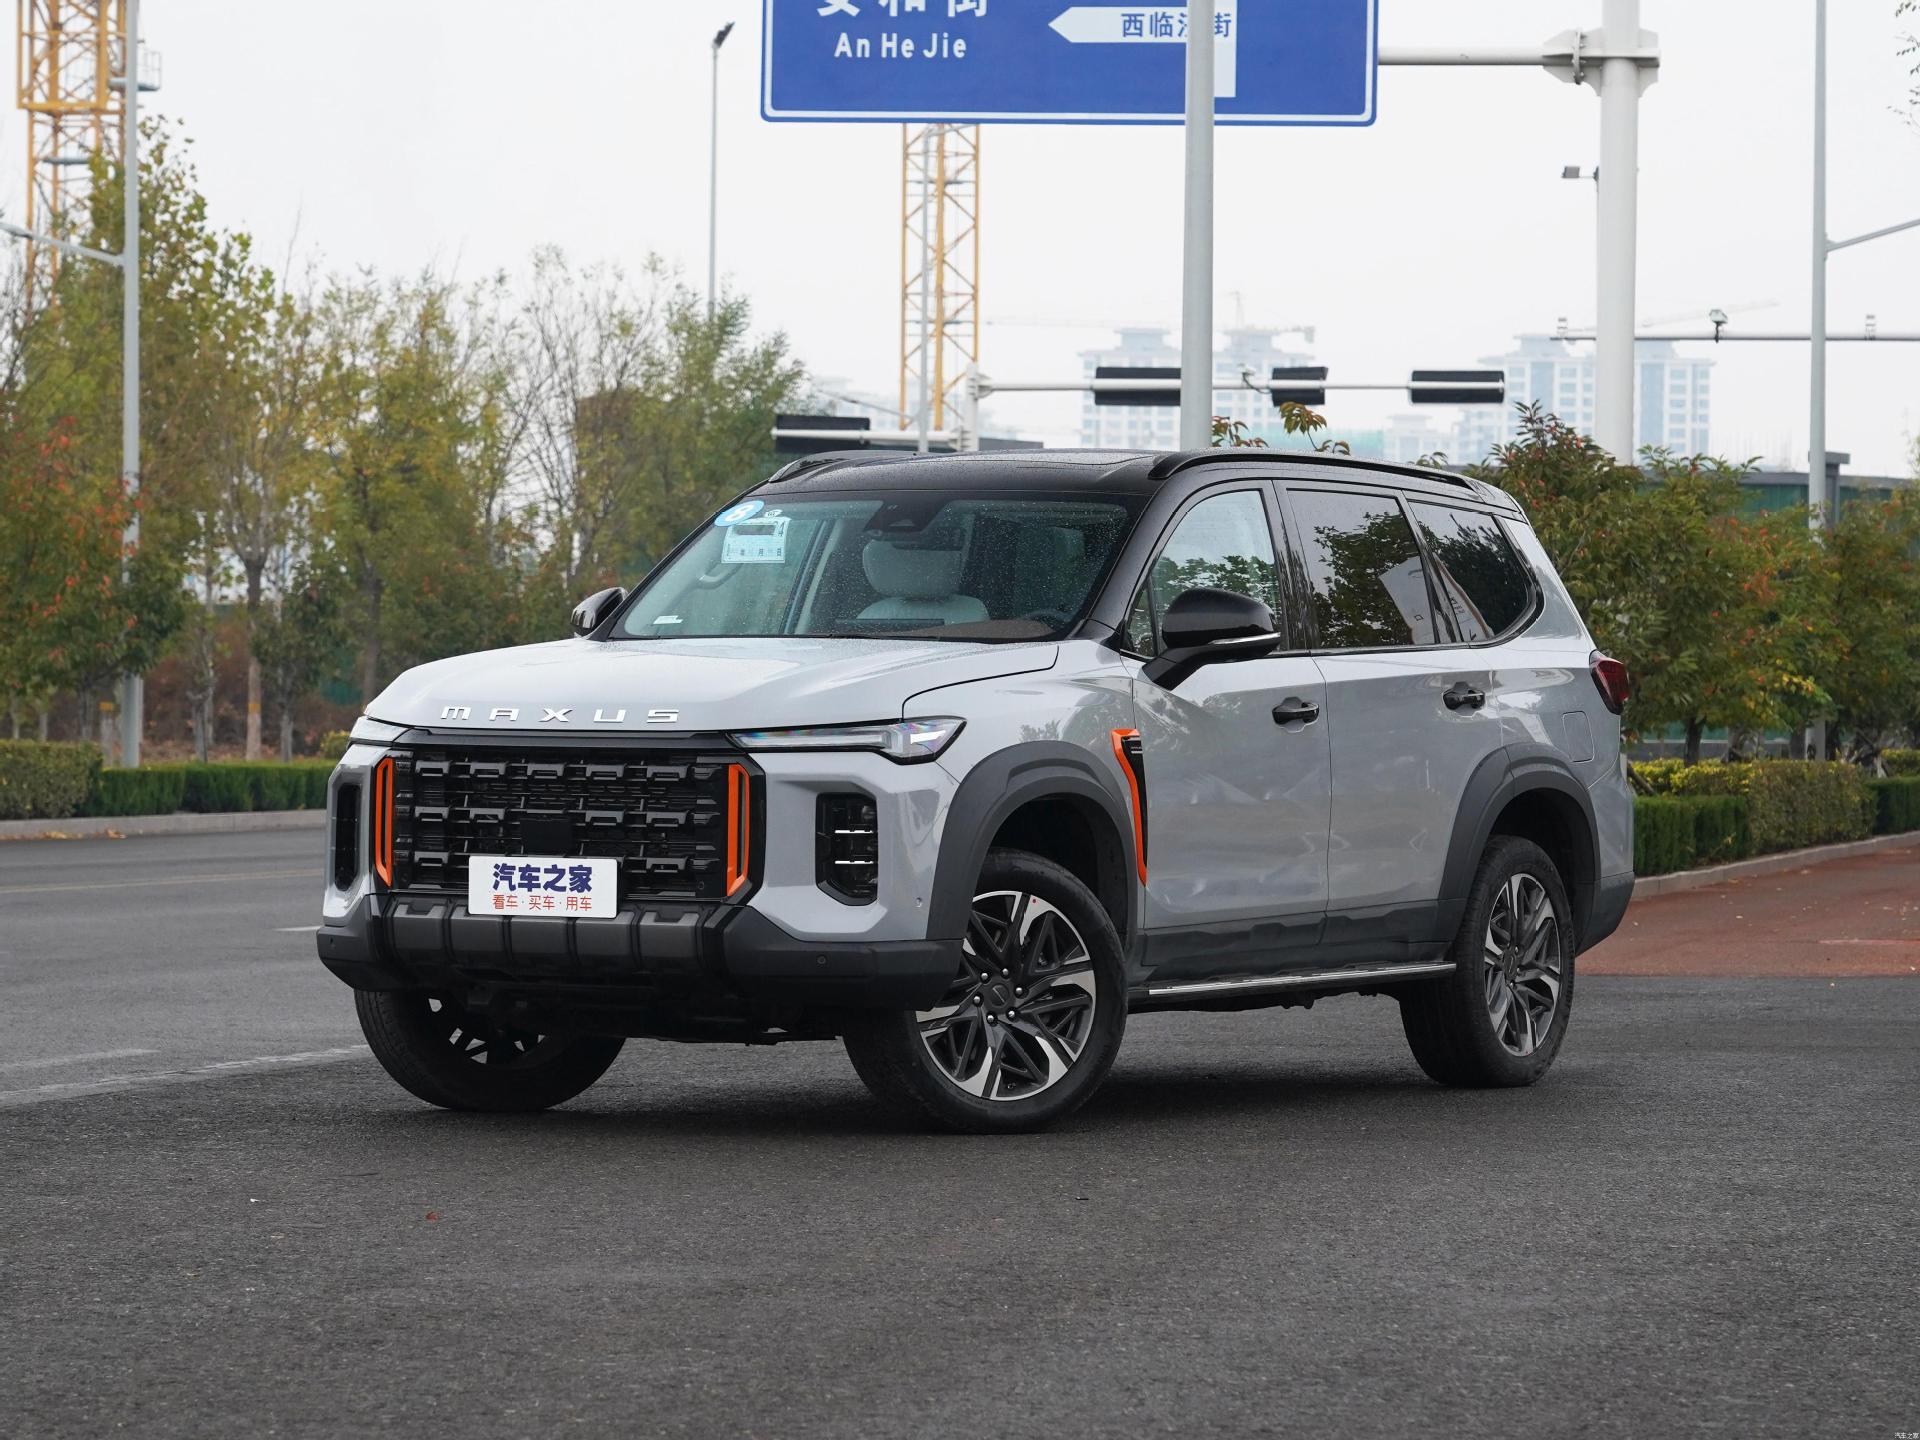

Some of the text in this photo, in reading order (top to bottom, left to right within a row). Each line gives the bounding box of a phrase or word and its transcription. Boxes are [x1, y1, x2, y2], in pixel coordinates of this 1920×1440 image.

[834, 32, 967, 58] An He Jie
[440, 705, 680, 724] MAXUS
[492, 863, 593, 893] 汽车之家
